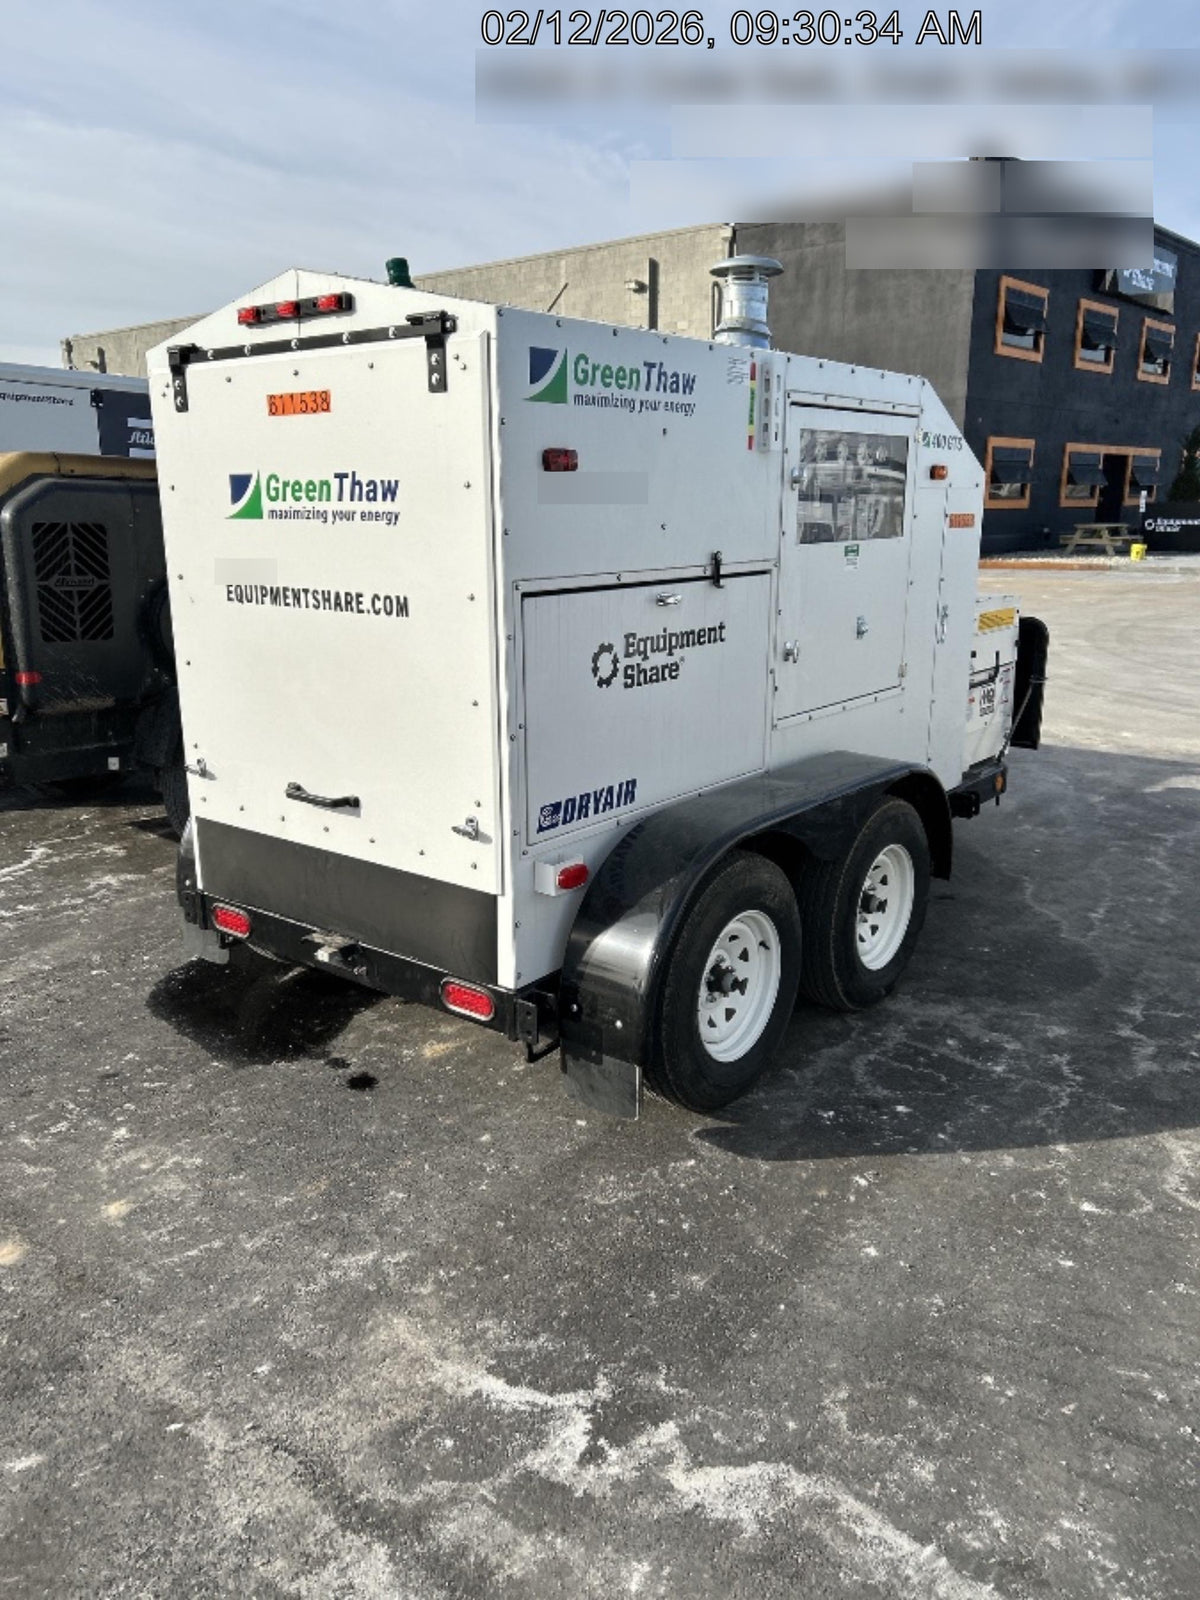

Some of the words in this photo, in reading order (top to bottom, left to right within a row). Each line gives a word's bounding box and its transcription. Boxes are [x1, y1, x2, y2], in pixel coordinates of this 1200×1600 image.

[573, 352, 697, 396] GreenThaw
[268, 390, 331, 415] 611538
[573, 392, 636, 414] maximizing
[638, 398, 661, 414] your
[663, 399, 697, 417] energy
[266, 470, 400, 503] GreenThaw
[267, 505, 328, 523] maximizing
[331, 509, 357, 525] your
[360, 510, 401, 526] energy
[226, 583, 410, 618] EQUIPMENTSHARE.COM
[623, 621, 726, 662] Equipment
[561, 778, 637, 826] DRYAIR
